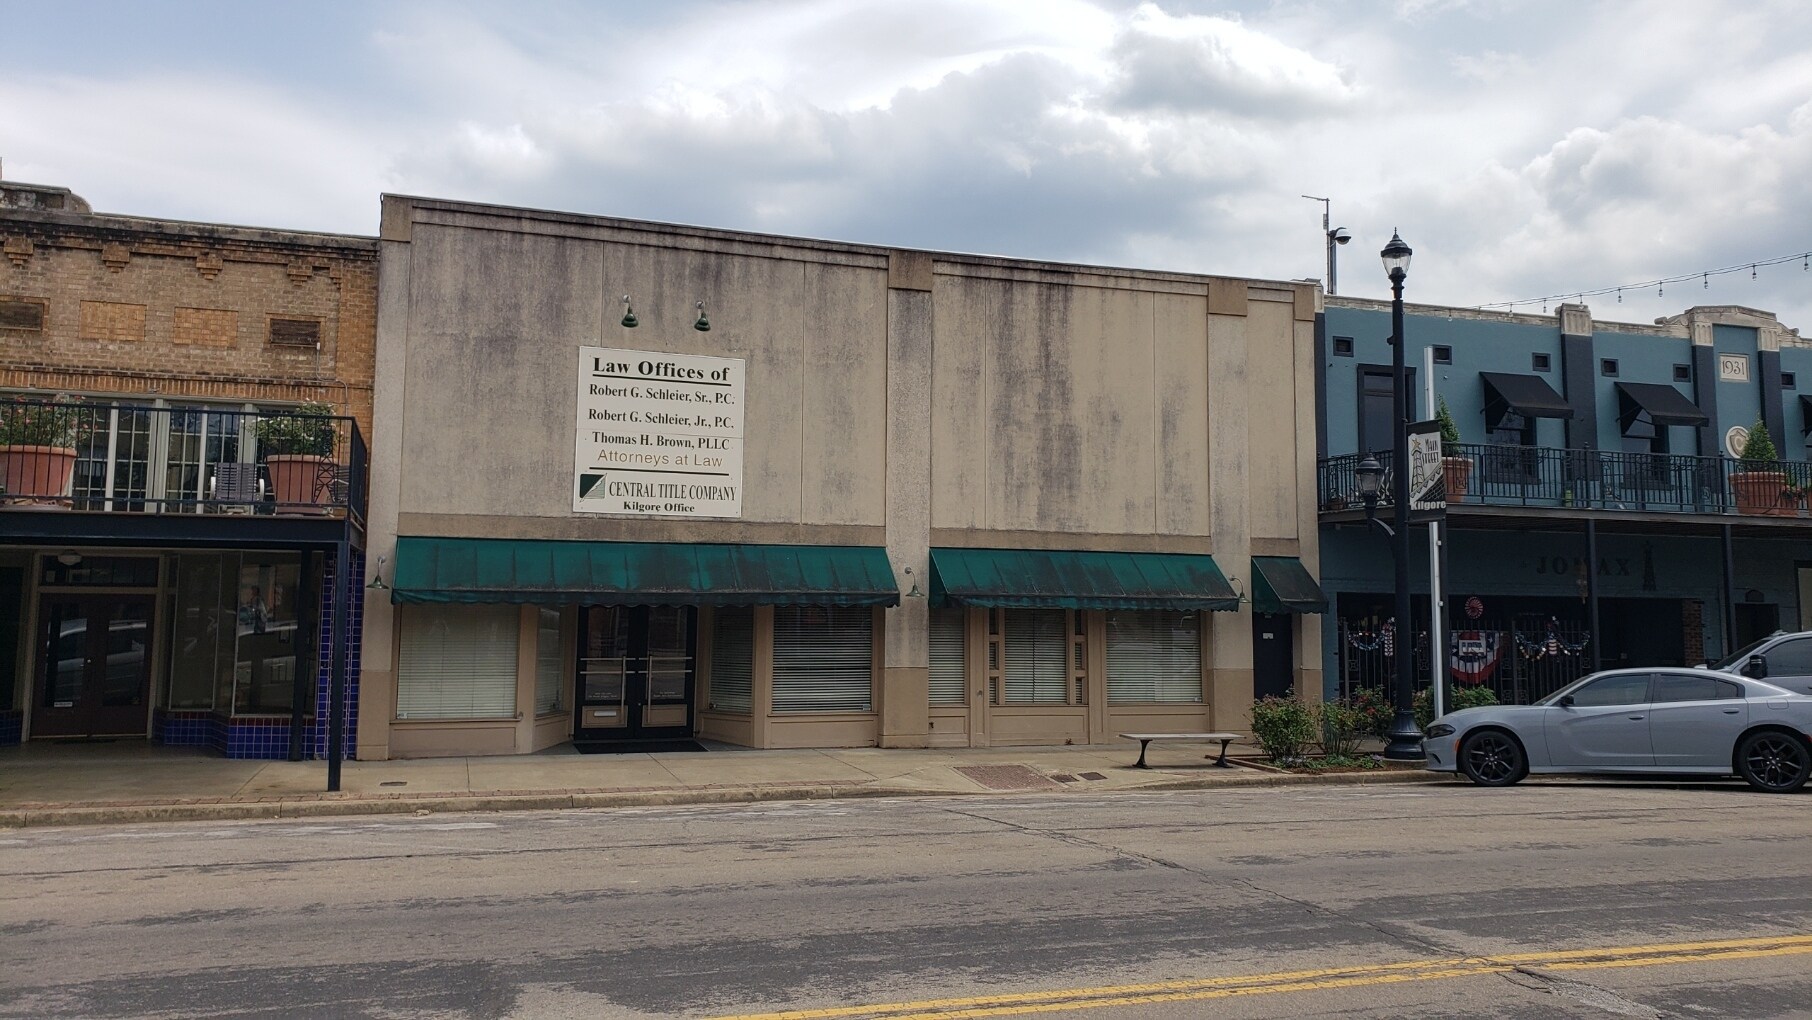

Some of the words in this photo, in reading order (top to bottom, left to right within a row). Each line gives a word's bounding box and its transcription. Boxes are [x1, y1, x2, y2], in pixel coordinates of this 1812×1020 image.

[593, 357, 630, 373] Law
[638, 360, 704, 379] Offices
[711, 367, 730, 381] of
[1722, 360, 1745, 375] 1931
[590, 384, 627, 397] Robert
[631, 387, 642, 398] G.
[646, 388, 692, 403] Schleier,
[694, 391, 712, 404] Sr.,
[715, 392, 735, 404] P.C.
[589, 408, 626, 422] Robert
[630, 411, 642, 422] G.
[645, 412, 691, 427] Schleier,
[694, 415, 711, 428] Jr.,
[714, 417, 734, 429] P.C.
[592, 431, 637, 445] Thomas
[640, 434, 653, 446] H.
[656, 435, 694, 449] Brown,
[698, 438, 730, 450] PLLC
[598, 449, 669, 467] Attorneys
[675, 454, 688, 465] at
[694, 454, 723, 467] Law
[609, 481, 656, 498] CENTRAL
[658, 484, 686, 499] TITLE
[689, 486, 737, 501] COMPANY
[623, 501, 661, 512] Kilgore
[664, 502, 695, 512] Office
[1411, 500, 1446, 510] Kilgore
